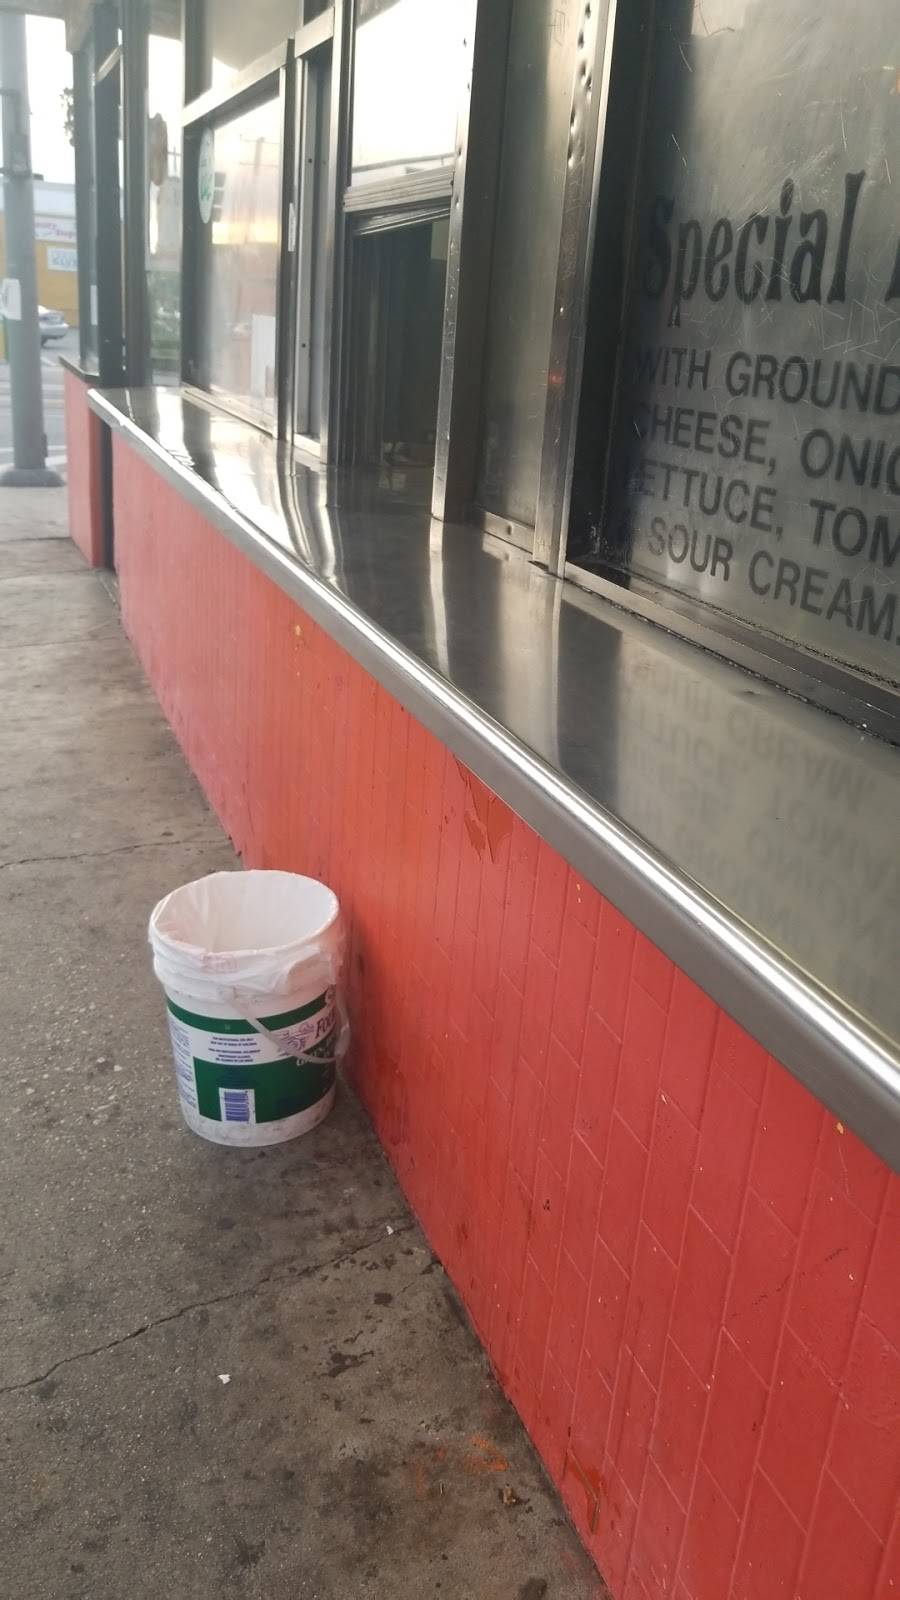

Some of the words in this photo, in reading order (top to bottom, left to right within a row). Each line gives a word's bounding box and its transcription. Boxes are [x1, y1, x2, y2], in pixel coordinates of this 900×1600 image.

[643, 169, 866, 328] Special
[635, 345, 711, 391] WITH
[724, 351, 900, 416] GROUND
[648, 516, 734, 582] SOUR
